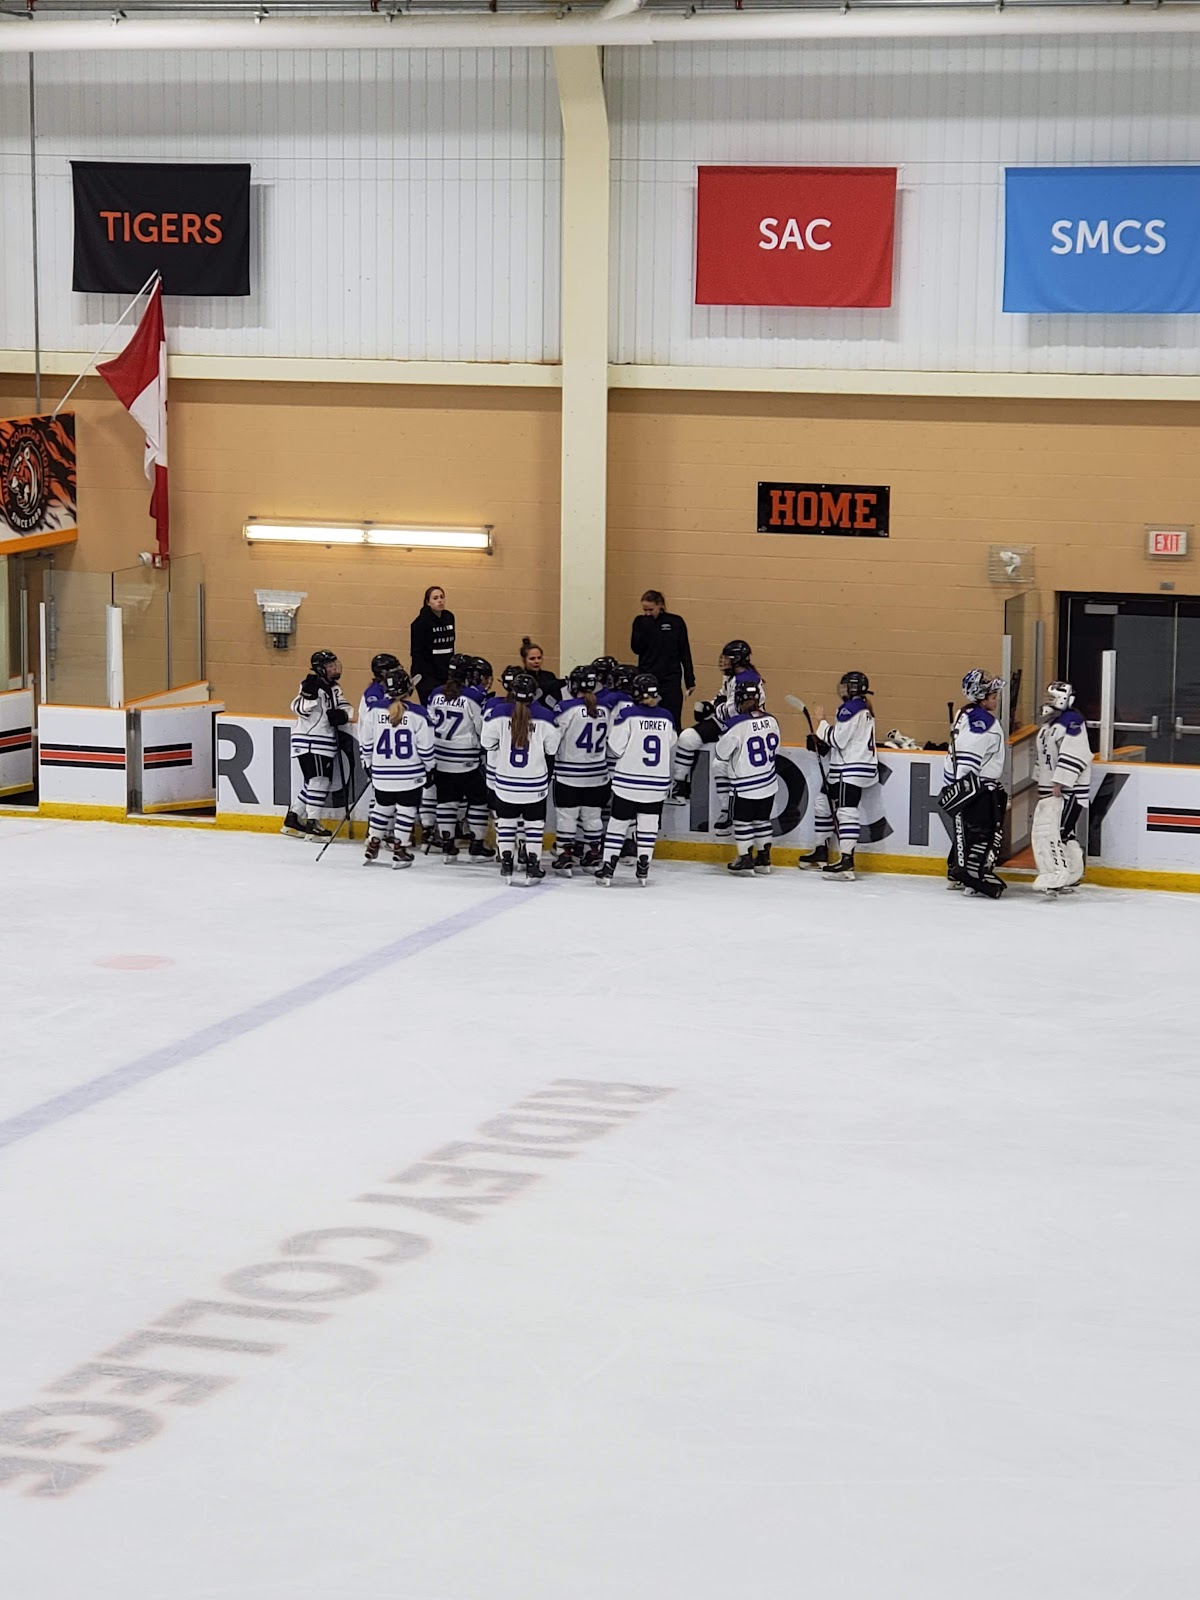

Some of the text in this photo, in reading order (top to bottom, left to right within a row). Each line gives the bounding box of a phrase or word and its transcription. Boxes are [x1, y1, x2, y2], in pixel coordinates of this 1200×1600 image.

[100, 210, 223, 245] TIGERS
[758, 217, 832, 251] SAC
[1050, 219, 1167, 255] SMCS
[9, 426, 41, 448] COLLEGE
[11, 511, 29, 529] SINCE
[769, 489, 878, 530] HOME
[1154, 533, 1182, 553] EXIT
[434, 708, 465, 741] 27
[575, 722, 608, 754] 42
[638, 719, 668, 732] YORKEY
[752, 718, 773, 732] BLAIR
[376, 728, 413, 760] 48
[642, 734, 662, 768] 9
[746, 732, 780, 768] 89
[350, 1077, 679, 1226] RIDLEY
